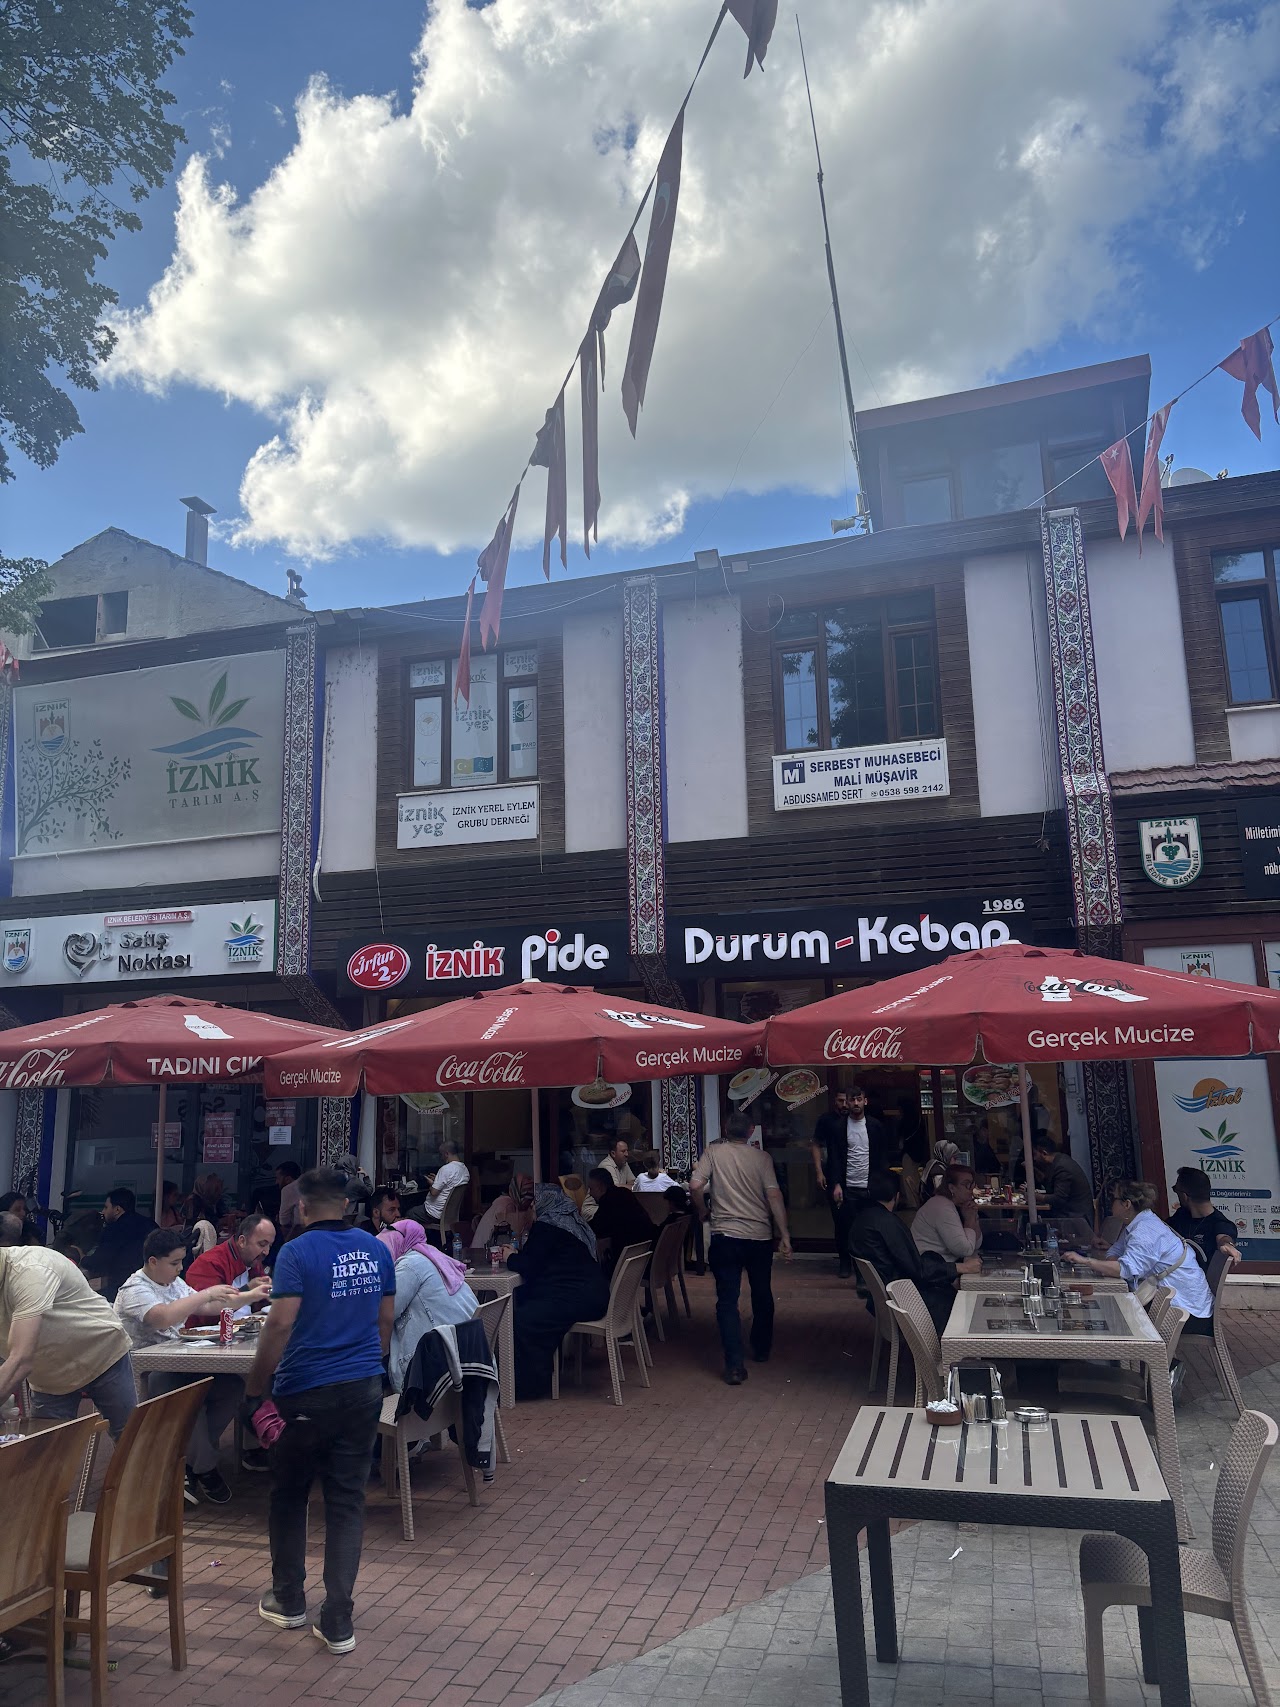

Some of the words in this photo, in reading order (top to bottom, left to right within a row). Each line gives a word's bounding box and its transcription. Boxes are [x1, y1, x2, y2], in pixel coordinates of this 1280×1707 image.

[810, 757, 861, 773] SERBEST
[864, 747, 941, 768] MUHASEBECİ
[165, 755, 262, 795] İZNİK
[833, 771, 862, 788] MALİ
[865, 767, 918, 785] MÜŞAVİR
[168, 794, 224, 809] TARIM
[783, 791, 840, 806] ABDUSSAMED
[841, 788, 864, 800] SERT
[879, 786, 901, 797] 0538
[903, 786, 920, 795] 598
[922, 784, 944, 793] 2142
[452, 804, 477, 816] İZNİK
[478, 803, 505, 814] YEREL
[506, 801, 536, 812] EYLEM
[411, 823, 445, 839] yeg
[457, 818, 489, 829] GRUBU
[490, 814, 530, 827] DERNEĞİ
[982, 898, 1025, 914] 1986
[119, 930, 171, 951] Satış
[118, 953, 194, 972] Noktası
[353, 948, 396, 977] İrfan
[425, 940, 505, 981] İZNİK
[823, 1026, 907, 1060] Coca-Cola
[1027, 1026, 1109, 1050] Gerçek
[1115, 1023, 1195, 1045] Mucize
[147, 1057, 220, 1076] TADINI
[636, 1049, 690, 1069] Gerçek
[693, 1045, 743, 1062] Mucize
[279, 1069, 309, 1088] Gerçek
[310, 1067, 342, 1084] Mucize
[435, 1050, 529, 1087] Coca-Cola
[1198, 1157, 1246, 1173] İZNİK
[337, 1249, 370, 1264] İZNİK
[332, 1261, 379, 1278] İRFAN
